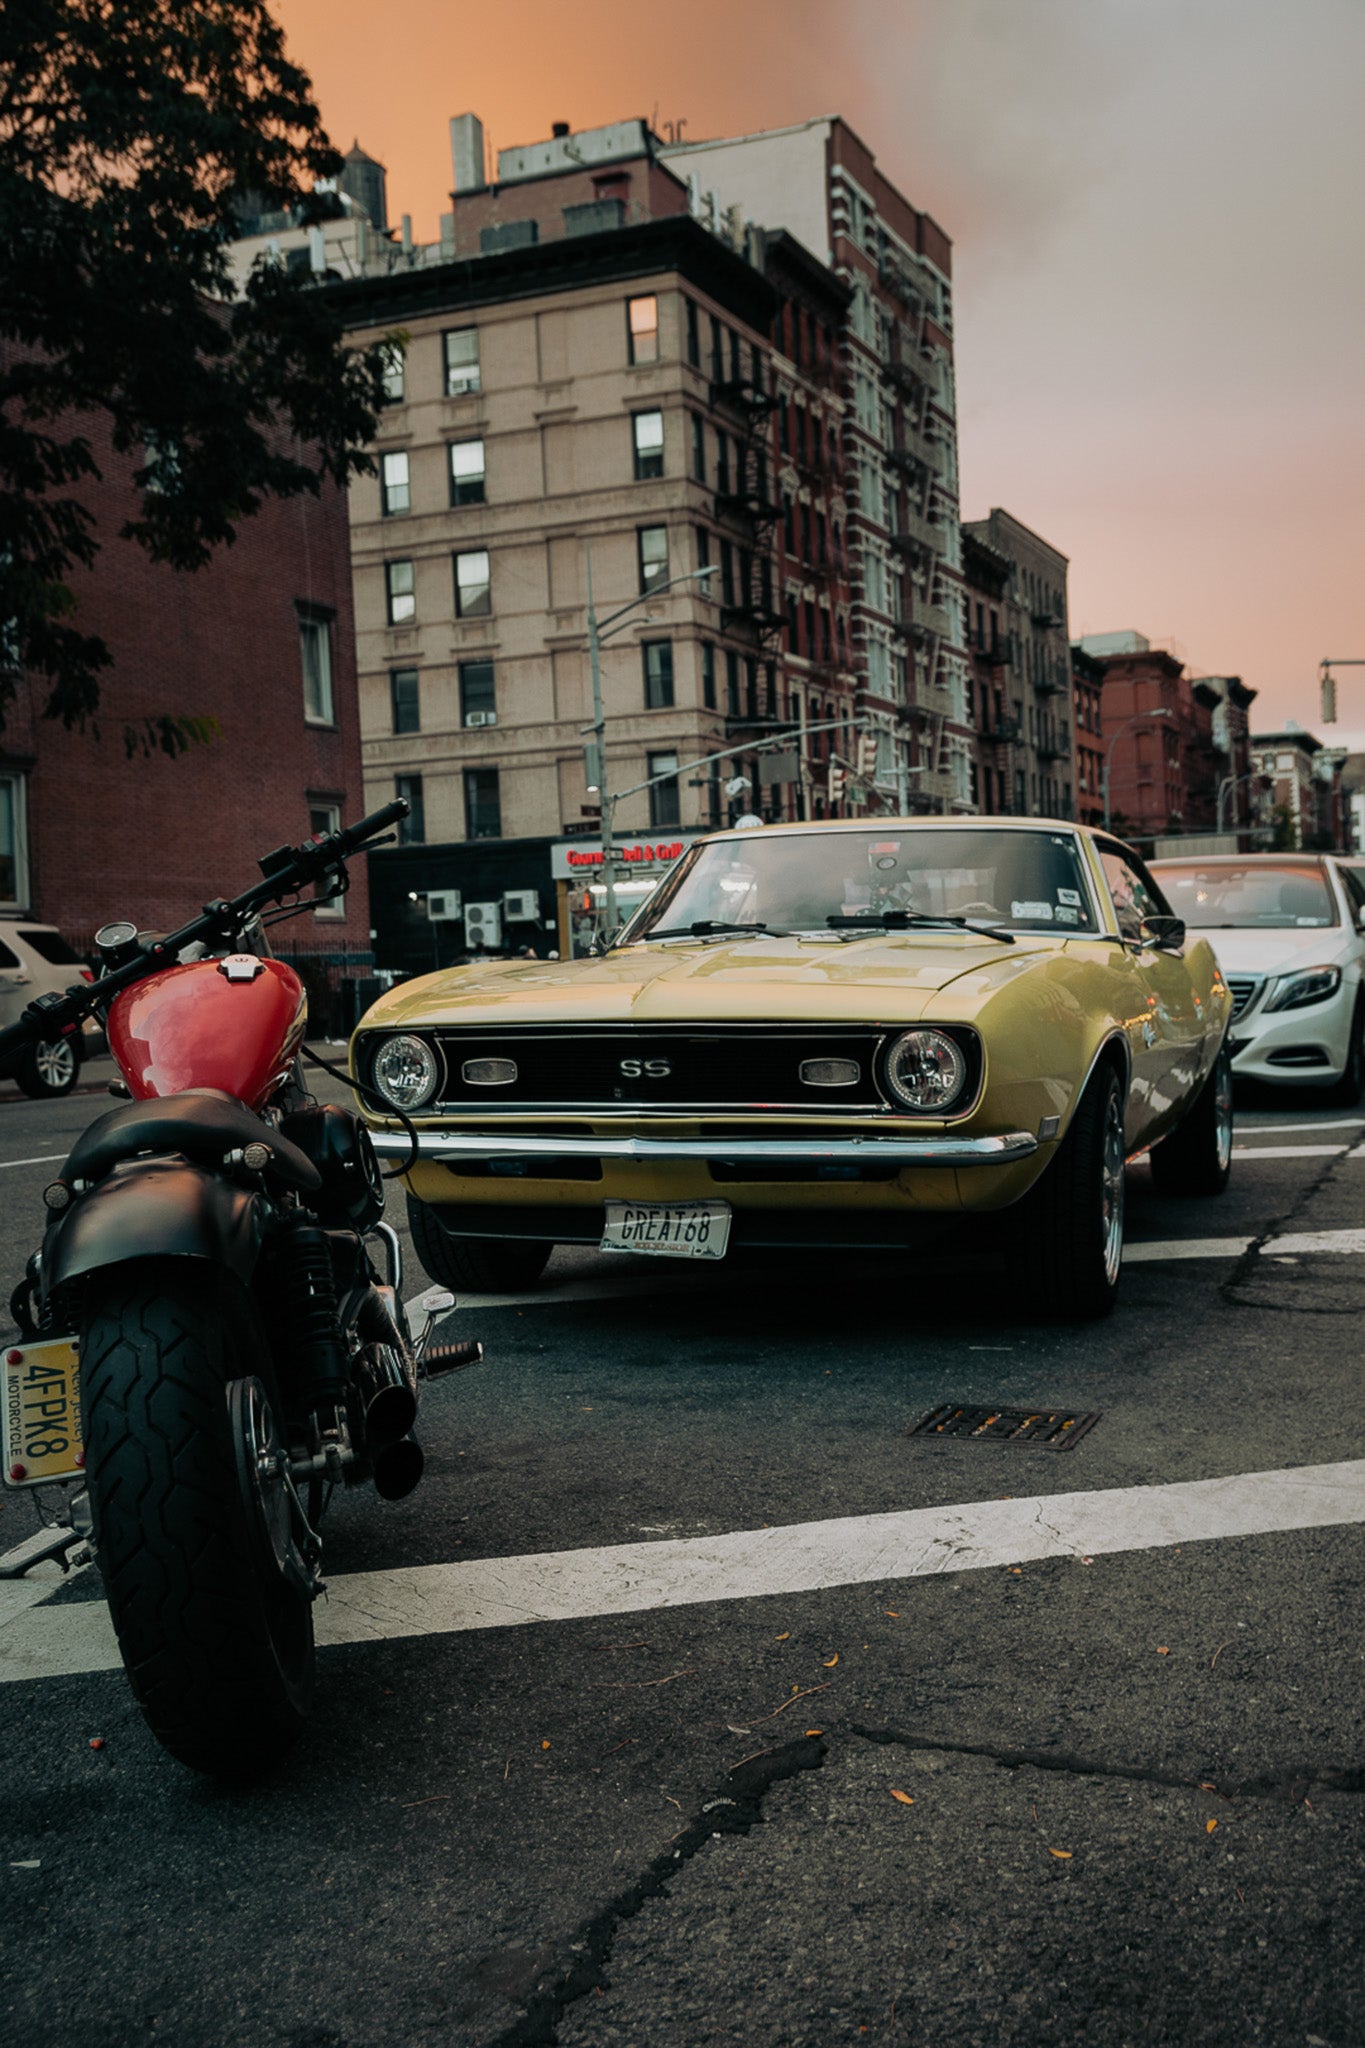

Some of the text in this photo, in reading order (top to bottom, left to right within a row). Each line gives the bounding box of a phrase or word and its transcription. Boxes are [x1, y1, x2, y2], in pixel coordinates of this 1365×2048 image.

[644, 844, 654, 861] &
[656, 842, 683, 861] Grill
[620, 1060, 671, 1077] SS
[621, 1210, 711, 1243] GREAT68
[7, 1375, 22, 1457] MOTORCYCLE
[23, 1365, 69, 1458] 4FPK8
